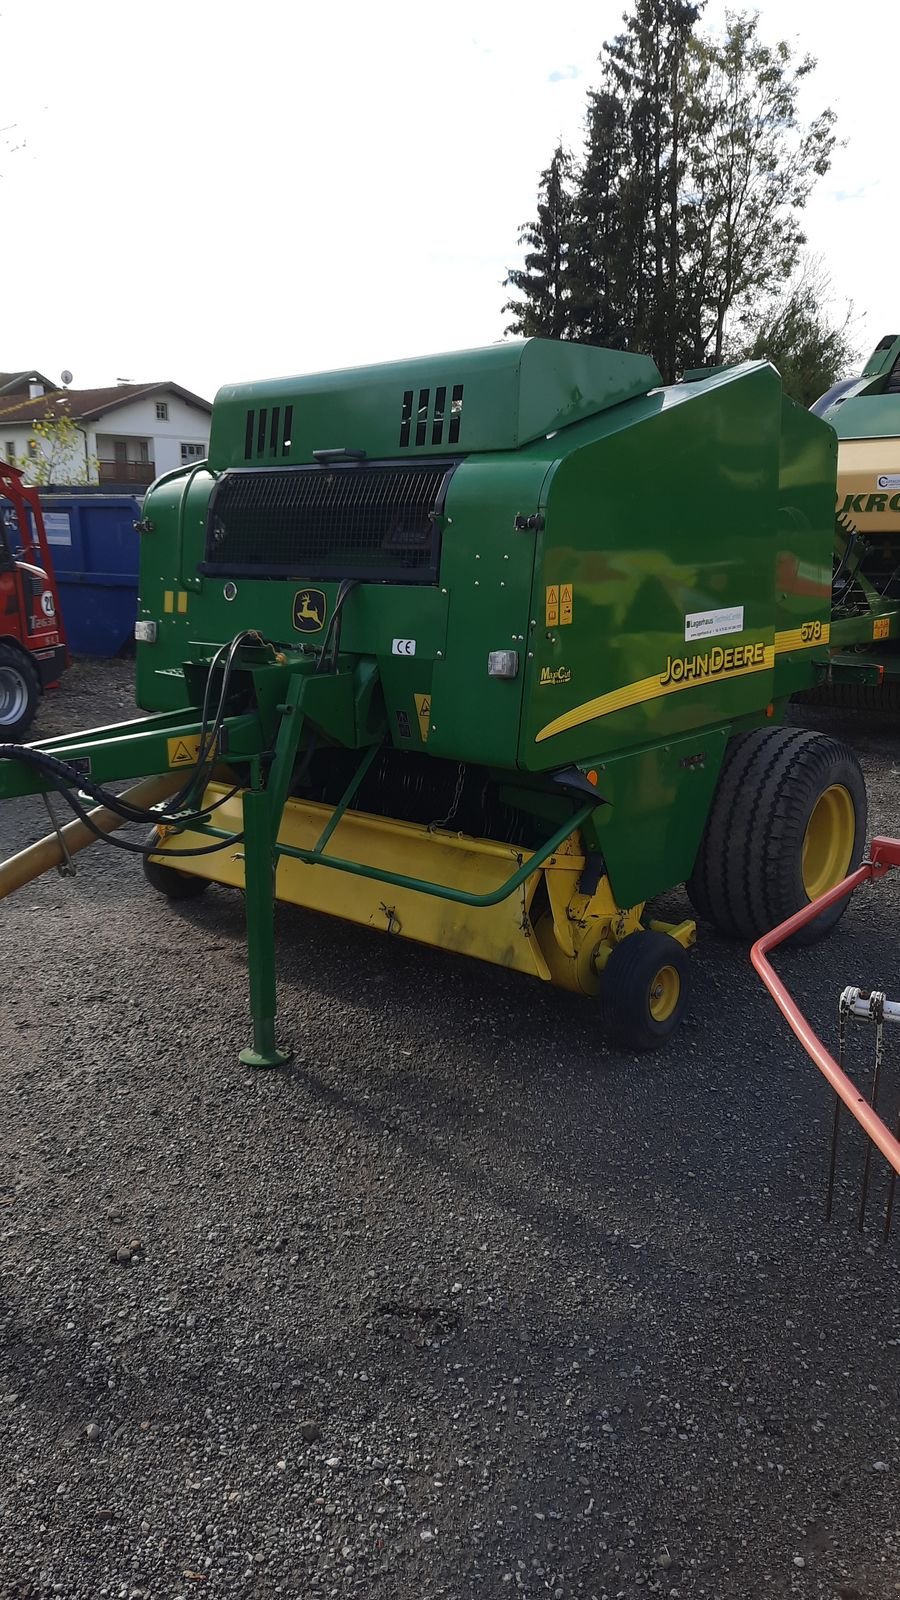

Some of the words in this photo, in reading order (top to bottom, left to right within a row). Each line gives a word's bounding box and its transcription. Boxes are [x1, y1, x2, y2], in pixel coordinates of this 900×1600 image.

[691, 617, 714, 629] Lagerhaus
[801, 620, 822, 641] 578
[397, 640, 411, 654] CE
[659, 655, 710, 683] JOHN
[711, 642, 766, 673] DEERE
